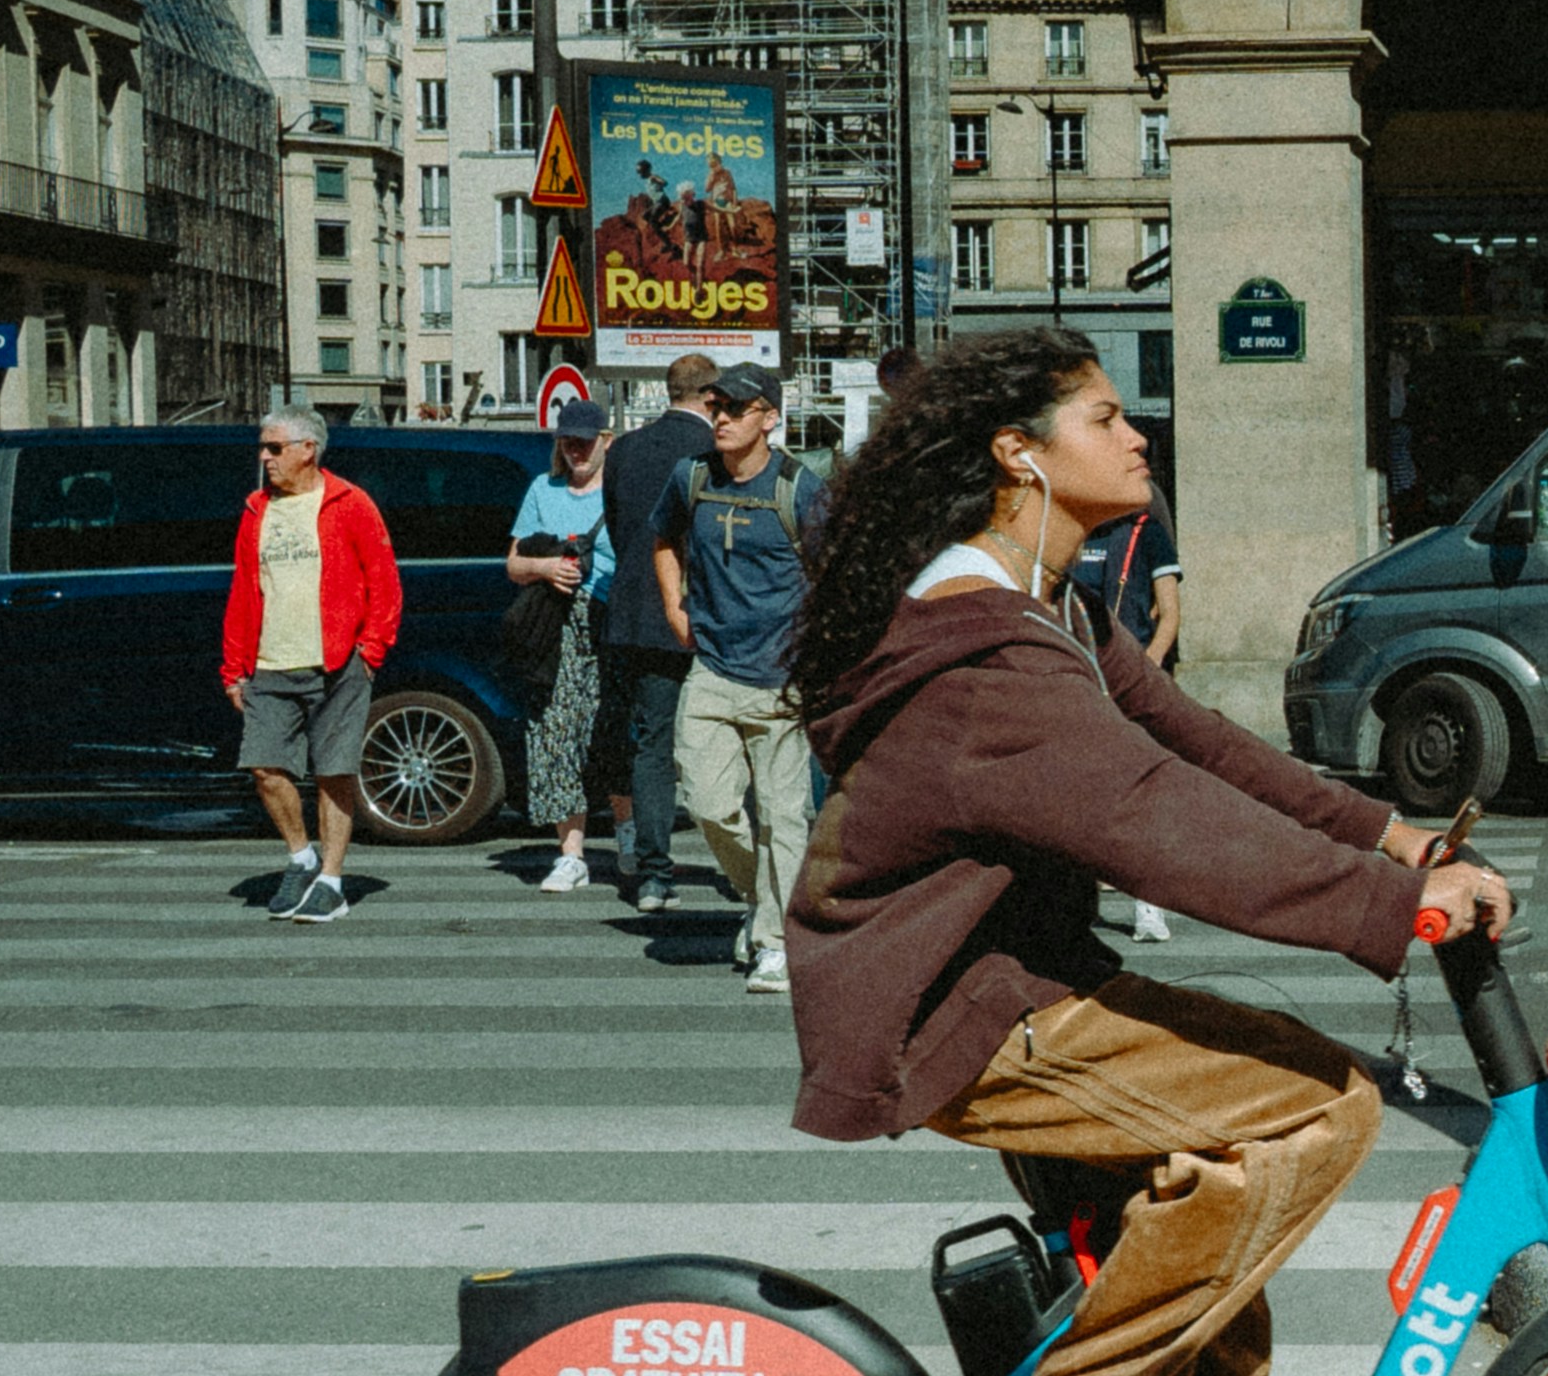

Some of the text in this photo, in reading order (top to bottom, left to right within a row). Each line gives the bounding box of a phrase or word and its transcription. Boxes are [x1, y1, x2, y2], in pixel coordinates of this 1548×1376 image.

[613, 95, 627, 104] on
[628, 96, 641, 104] ne
[675, 97, 709, 108] jamais
[602, 119, 638, 139] Les
[640, 121, 764, 159] Roches
[605, 267, 769, 319] Rouges
[1251, 315, 1273, 327] RUE
[655, 335, 705, 346] septembre
[707, 336, 718, 345] au
[1239, 337, 1286, 348] DE RIVOLI
[612, 1318, 746, 1367] ESSAI
